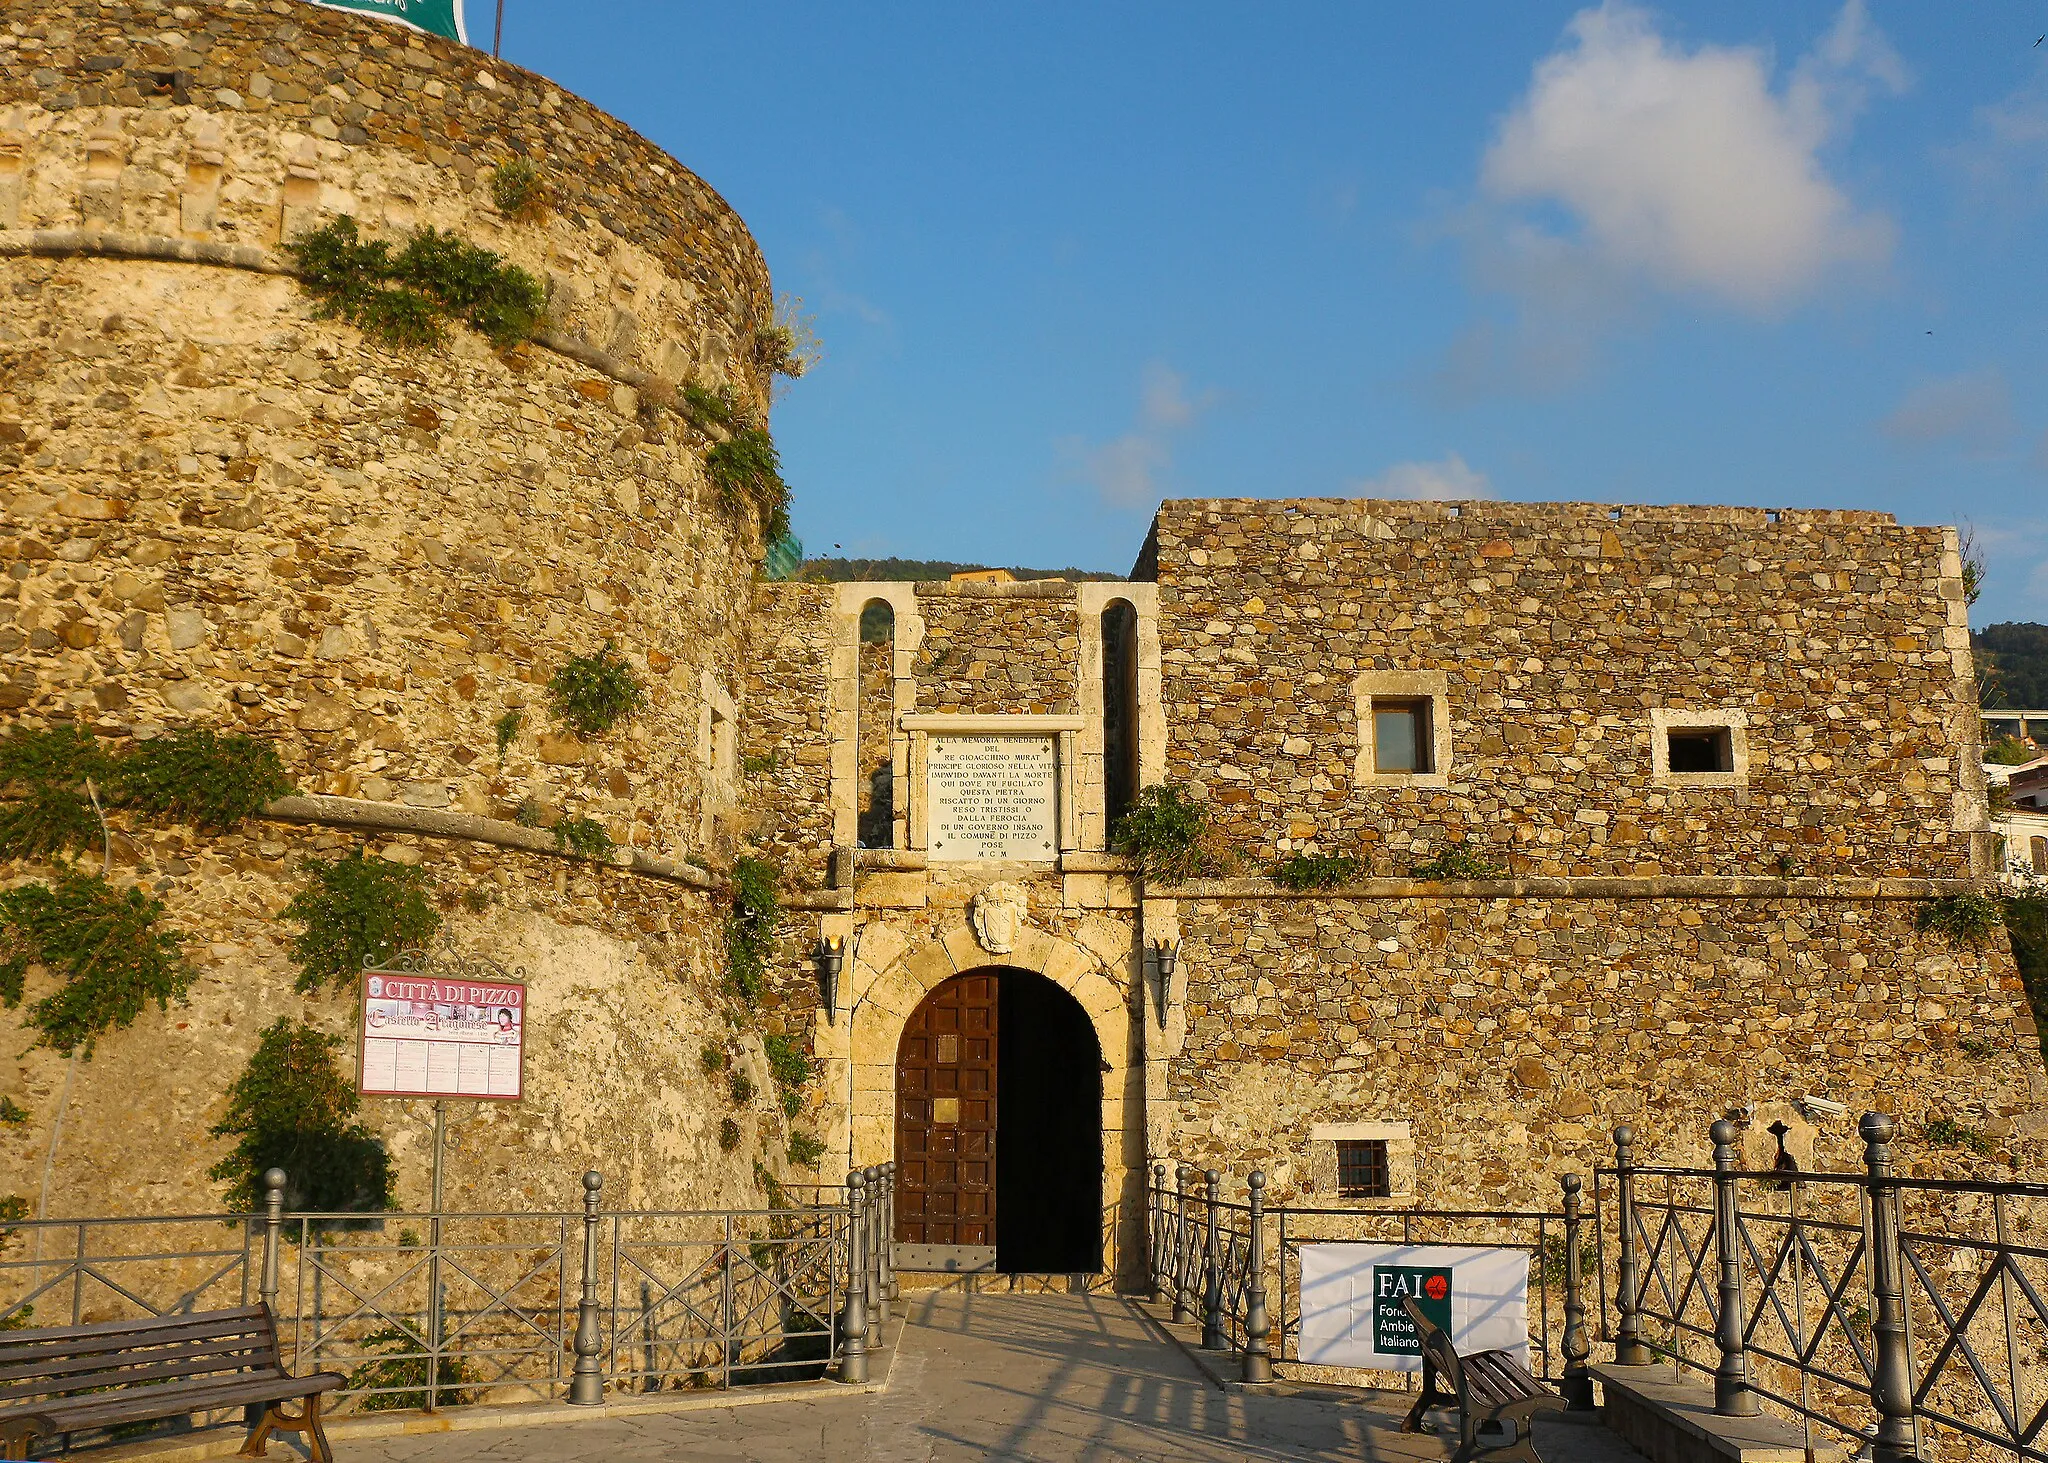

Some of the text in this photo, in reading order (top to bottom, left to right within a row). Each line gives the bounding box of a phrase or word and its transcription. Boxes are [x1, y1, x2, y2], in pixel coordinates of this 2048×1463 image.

[385, 981, 519, 1005] CITTÀ DI PIZZO
[367, 1009, 420, 1028] Castello
[1377, 1273, 1423, 1299] FAI
[1380, 1334, 1419, 1347] Italiano
